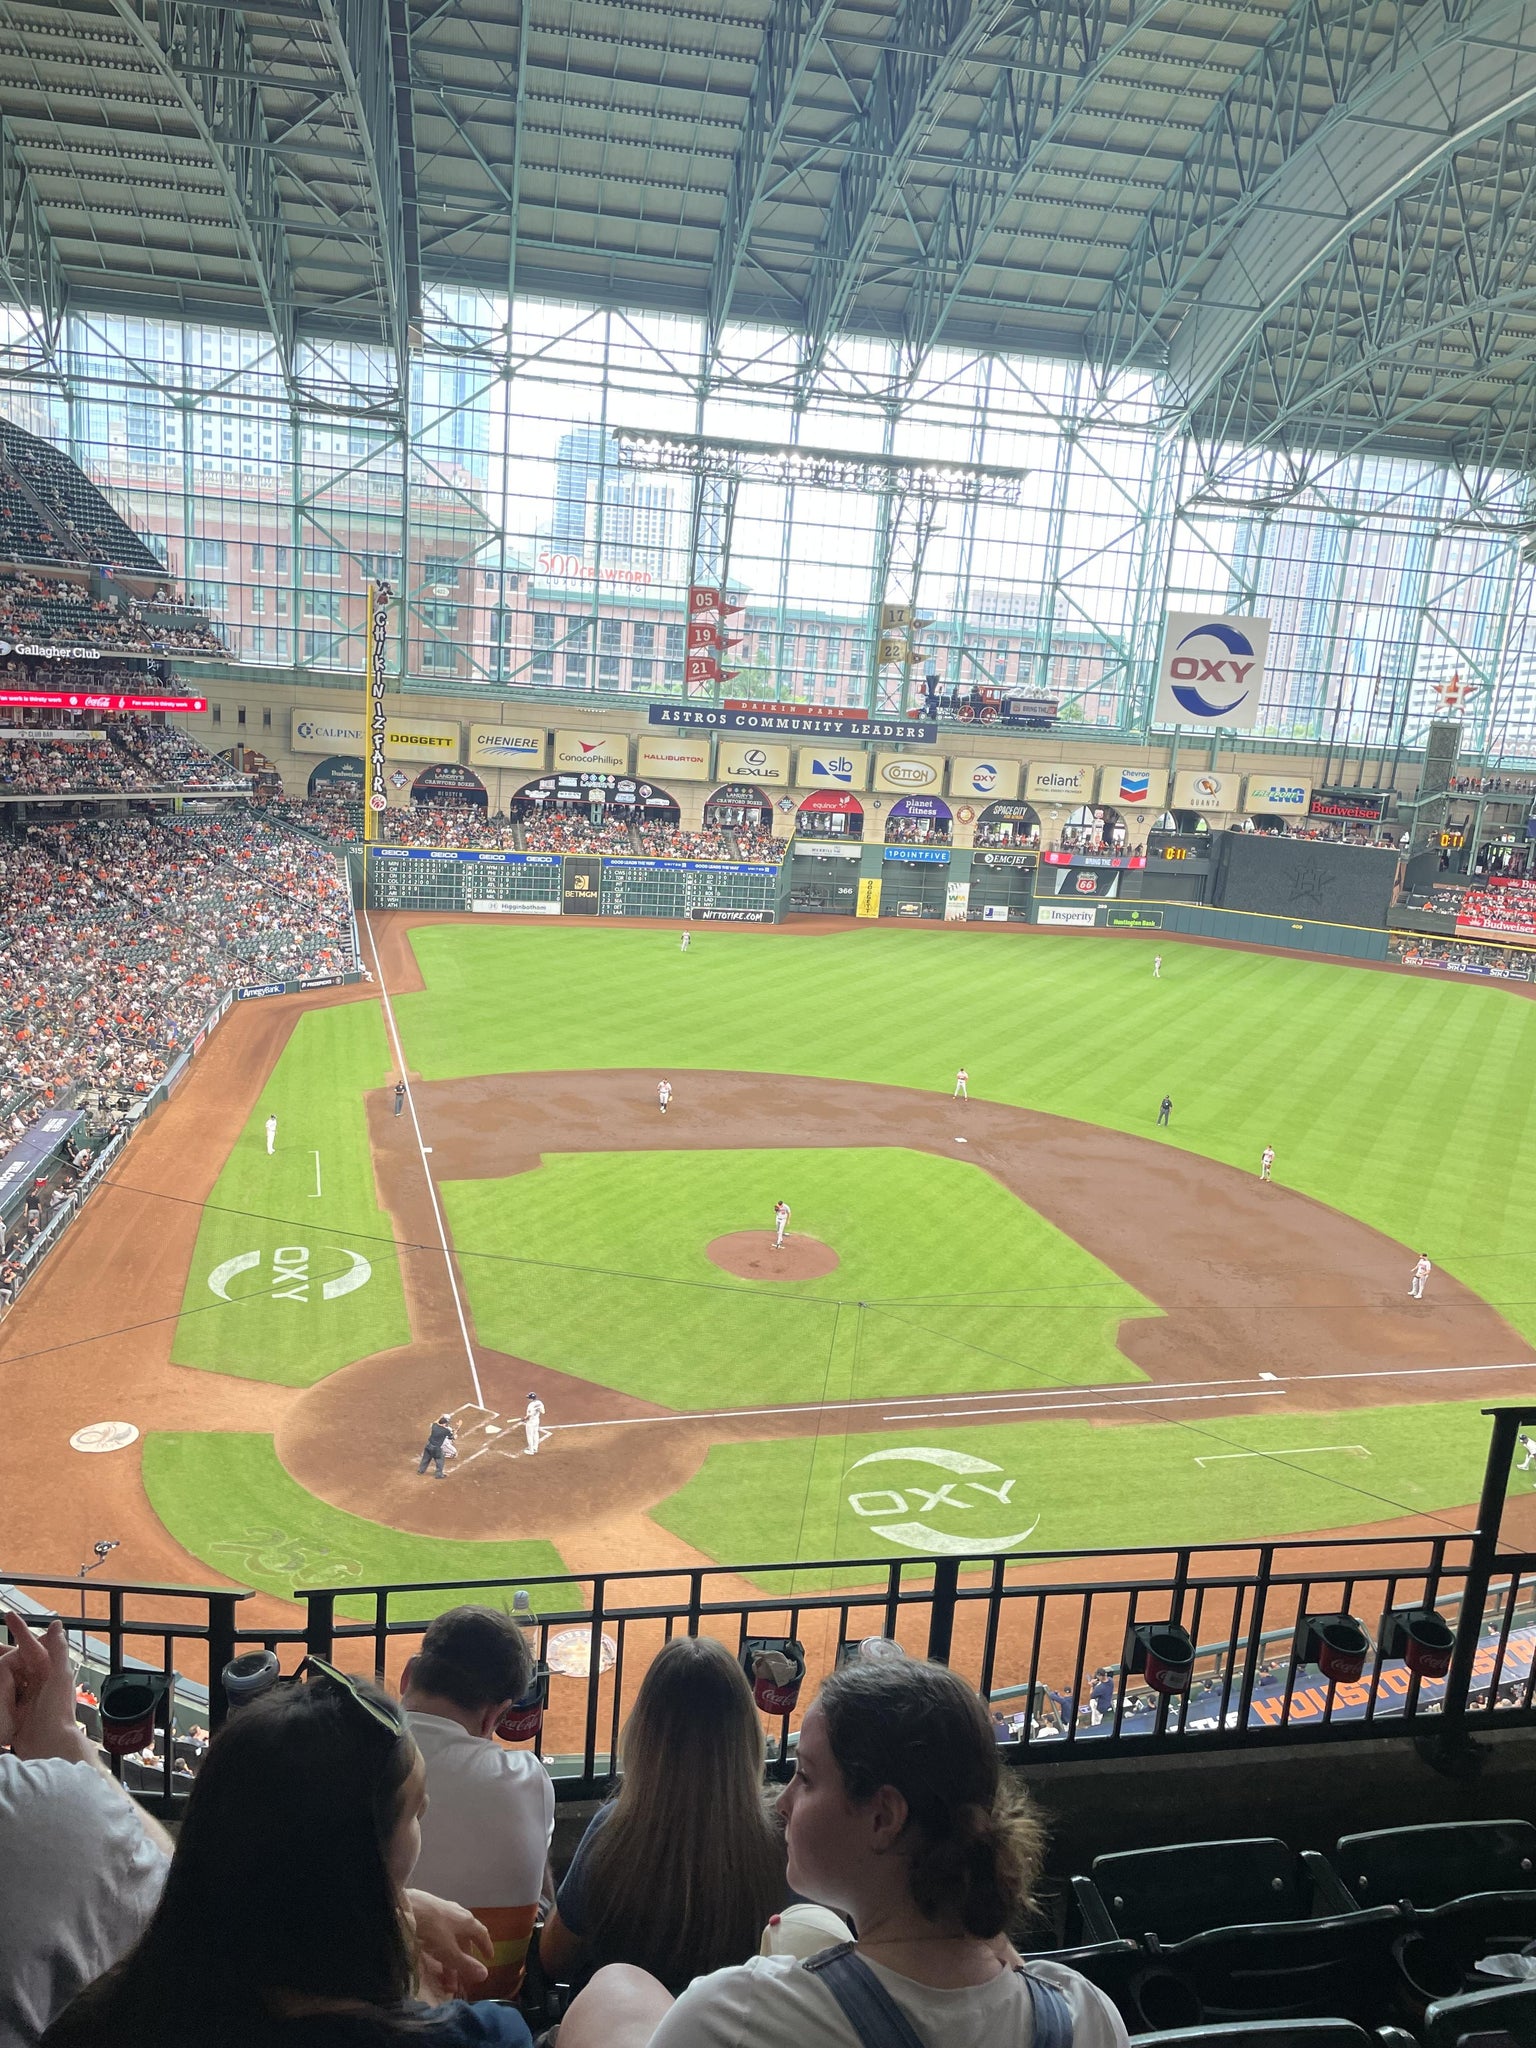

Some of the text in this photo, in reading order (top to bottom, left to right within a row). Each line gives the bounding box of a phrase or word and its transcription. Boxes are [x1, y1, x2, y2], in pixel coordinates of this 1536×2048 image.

[538, 552, 578, 576] 500
[579, 566, 652, 585] CRAWFORD
[695, 593, 713, 606] 05
[889, 609, 904, 622] 17
[695, 629, 711, 642] 19
[15, 644, 100, 659] Gallagher Club
[372, 611, 387, 699] CHIKIN
[884, 645, 900, 657] 22
[692, 662, 708, 674] 21
[1170, 656, 1256, 683] OXY
[741, 702, 844, 716] DAIKIN PARK
[661, 710, 925, 738] ASTROS COMMUNITY LEADERS
[315, 727, 363, 739] CALPINE
[390, 734, 453, 747] DOGGETT
[477, 735, 539, 748] CHENIERE
[371, 732, 385, 793] FAIR
[558, 752, 623, 766] ConocoPhillips
[644, 753, 704, 763] HALLIBURTON
[828, 756, 853, 773] slb
[331, 769, 364, 779] Budweiser
[435, 773, 465, 781] LANDRY'S
[727, 766, 780, 778] LEXUS
[888, 765, 929, 782] COTTON
[973, 774, 996, 782] OXY
[1122, 769, 1150, 777] Chevron
[424, 779, 456, 787] CRAWFORD
[1037, 773, 1079, 787] reliant
[1251, 789, 1298, 799] FREEPORT
[1268, 786, 1305, 804] LNG
[905, 799, 933, 808] planet
[1190, 798, 1220, 807] QUANTA
[908, 806, 937, 816] fitness
[993, 805, 1028, 816] SPACE CITY
[1310, 800, 1381, 820] Budweiser
[1440, 834, 1464, 847] 0:11
[349, 846, 364, 855] 315
[381, 849, 409, 857] GEICO
[889, 850, 947, 860] 1POINTFIVE
[1166, 848, 1187, 860] 0:11
[993, 855, 1027, 865] EMCJET
[1080, 880, 1093, 889] 66
[565, 890, 598, 898] BETMGM
[838, 887, 853, 895] 366
[501, 903, 547, 911] Higginbotham
[702, 910, 763, 922] NITTOTIRE.COM
[1051, 910, 1094, 922] Insperity
[1113, 919, 1156, 927] Huntington Bank
[1483, 919, 1536, 934] Budweiser
[271, 1246, 310, 1303] OXY
[848, 1479, 1017, 1516] OXY
